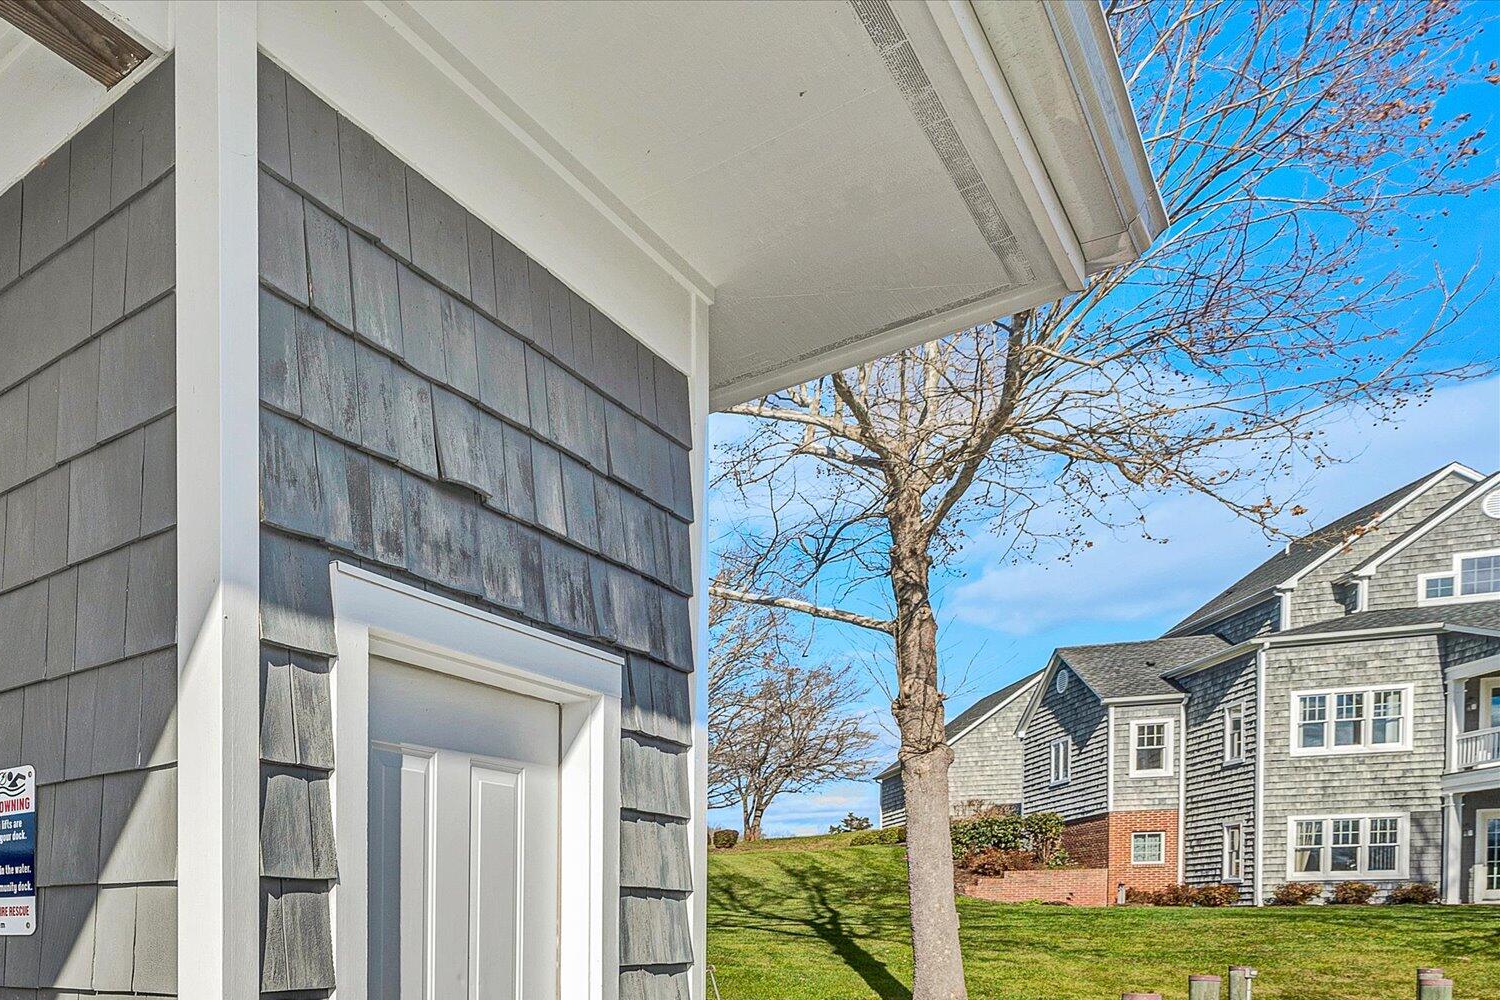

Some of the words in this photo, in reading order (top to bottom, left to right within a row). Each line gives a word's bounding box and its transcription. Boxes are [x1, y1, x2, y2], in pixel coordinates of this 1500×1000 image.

[2, 819, 12, 829] lifts
[13, 820, 22, 828] are
[0, 833, 11, 844] your
[12, 830, 27, 840] dock.
[0, 866, 4, 875] in
[5, 865, 14, 874] the
[15, 863, 31, 874] water.
[18, 881, 33, 891] dock.
[9, 906, 29, 916] RESCUE
